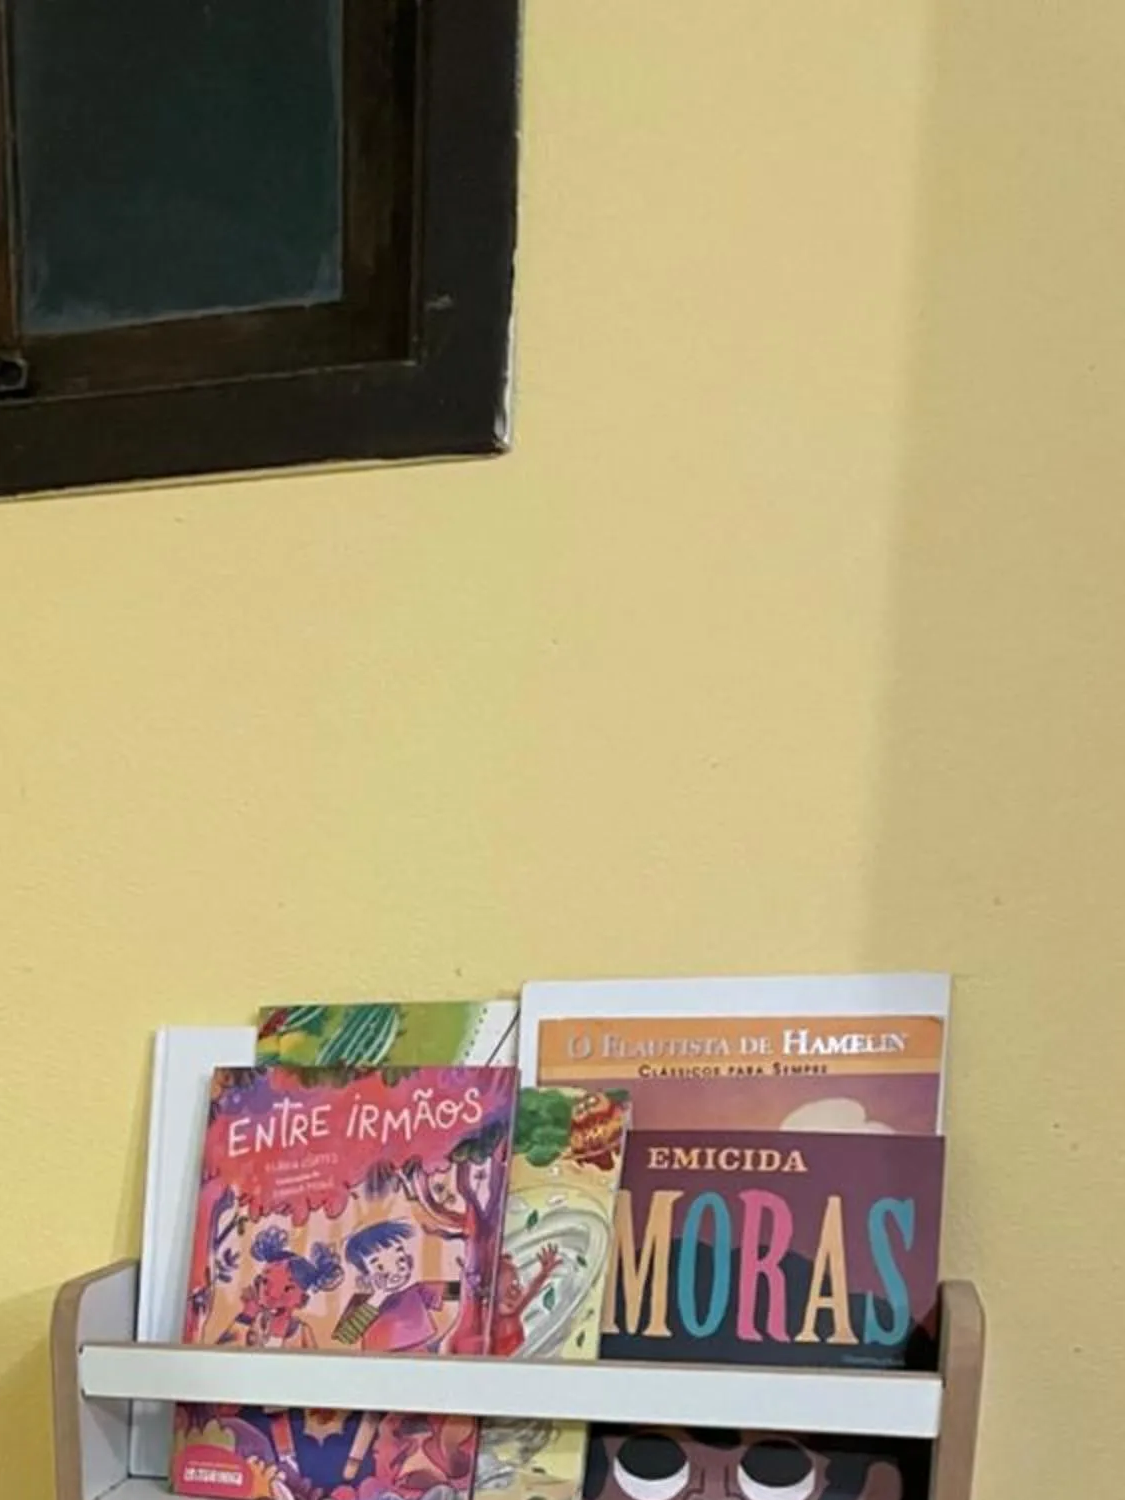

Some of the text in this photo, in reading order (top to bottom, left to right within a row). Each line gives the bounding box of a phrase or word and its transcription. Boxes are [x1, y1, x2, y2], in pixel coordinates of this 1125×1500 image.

[567, 1033, 593, 1061] O
[739, 1034, 774, 1056] DE
[228, 1097, 332, 1158] ENTRE
[647, 1147, 808, 1172] EMICIDA
